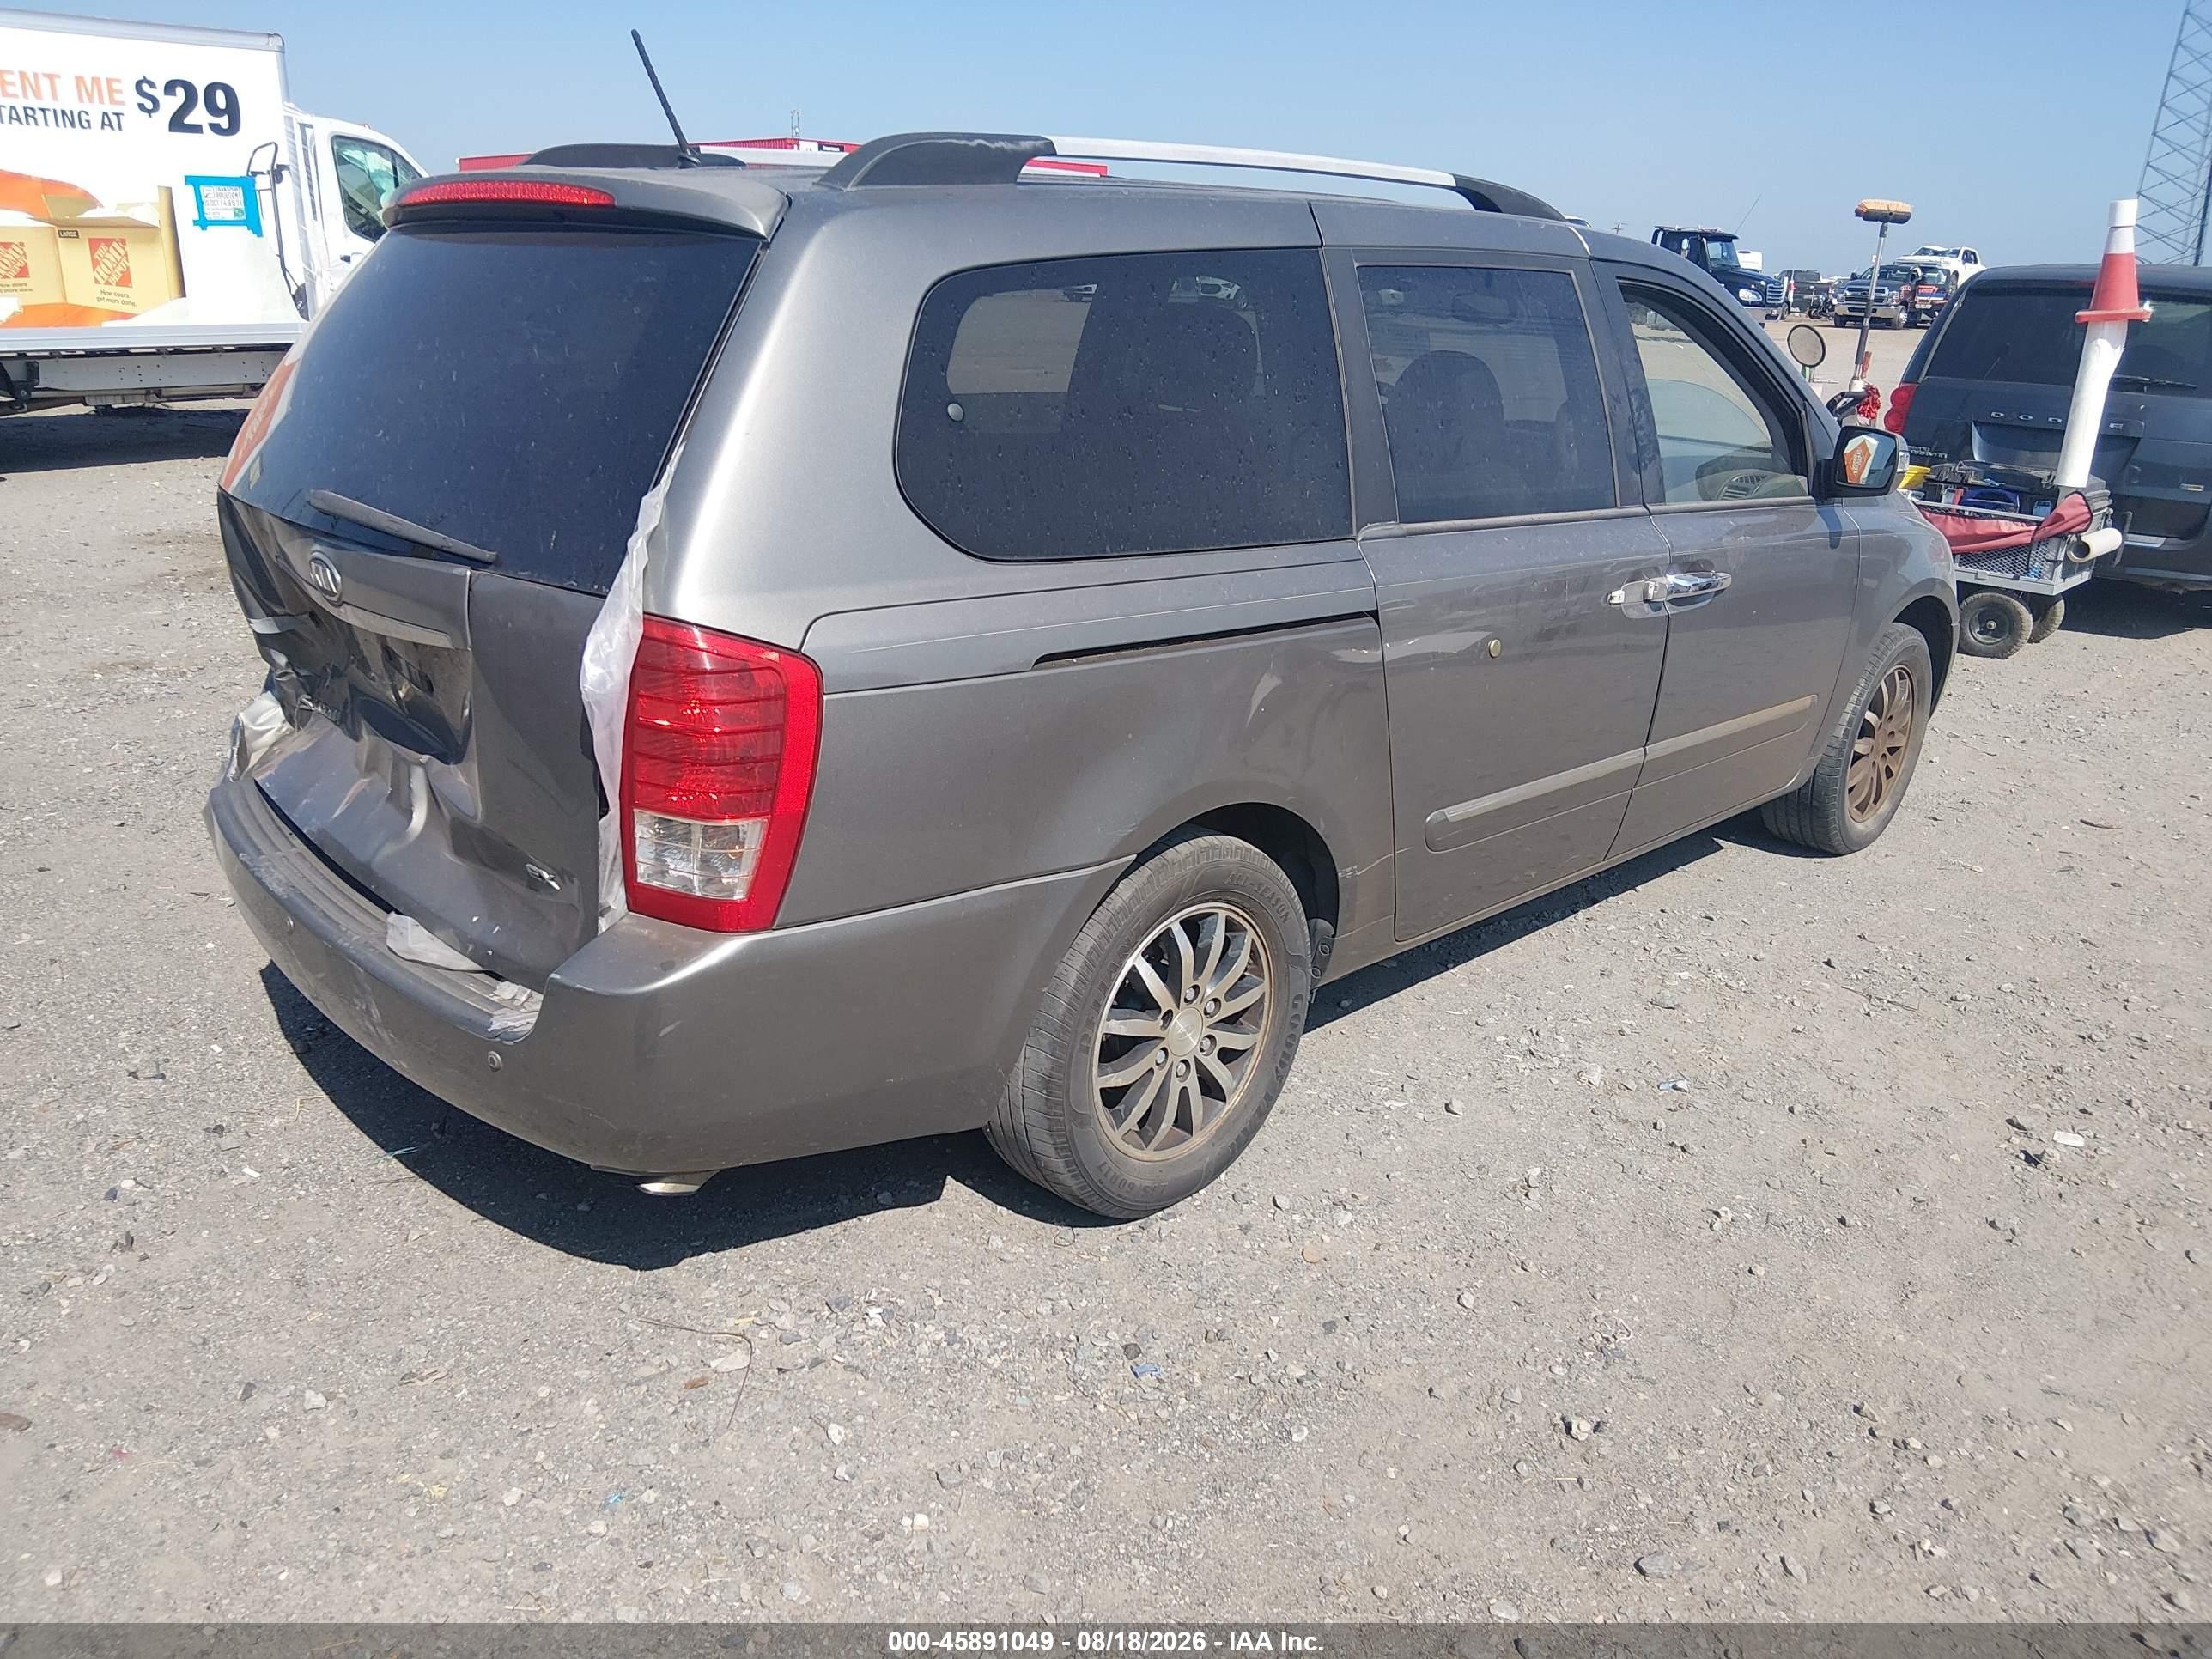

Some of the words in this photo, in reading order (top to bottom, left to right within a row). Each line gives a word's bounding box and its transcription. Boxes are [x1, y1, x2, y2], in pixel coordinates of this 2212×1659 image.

[74, 75, 126, 106] ME
[135, 75, 240, 137] $29
[100, 111, 125, 131] AT
